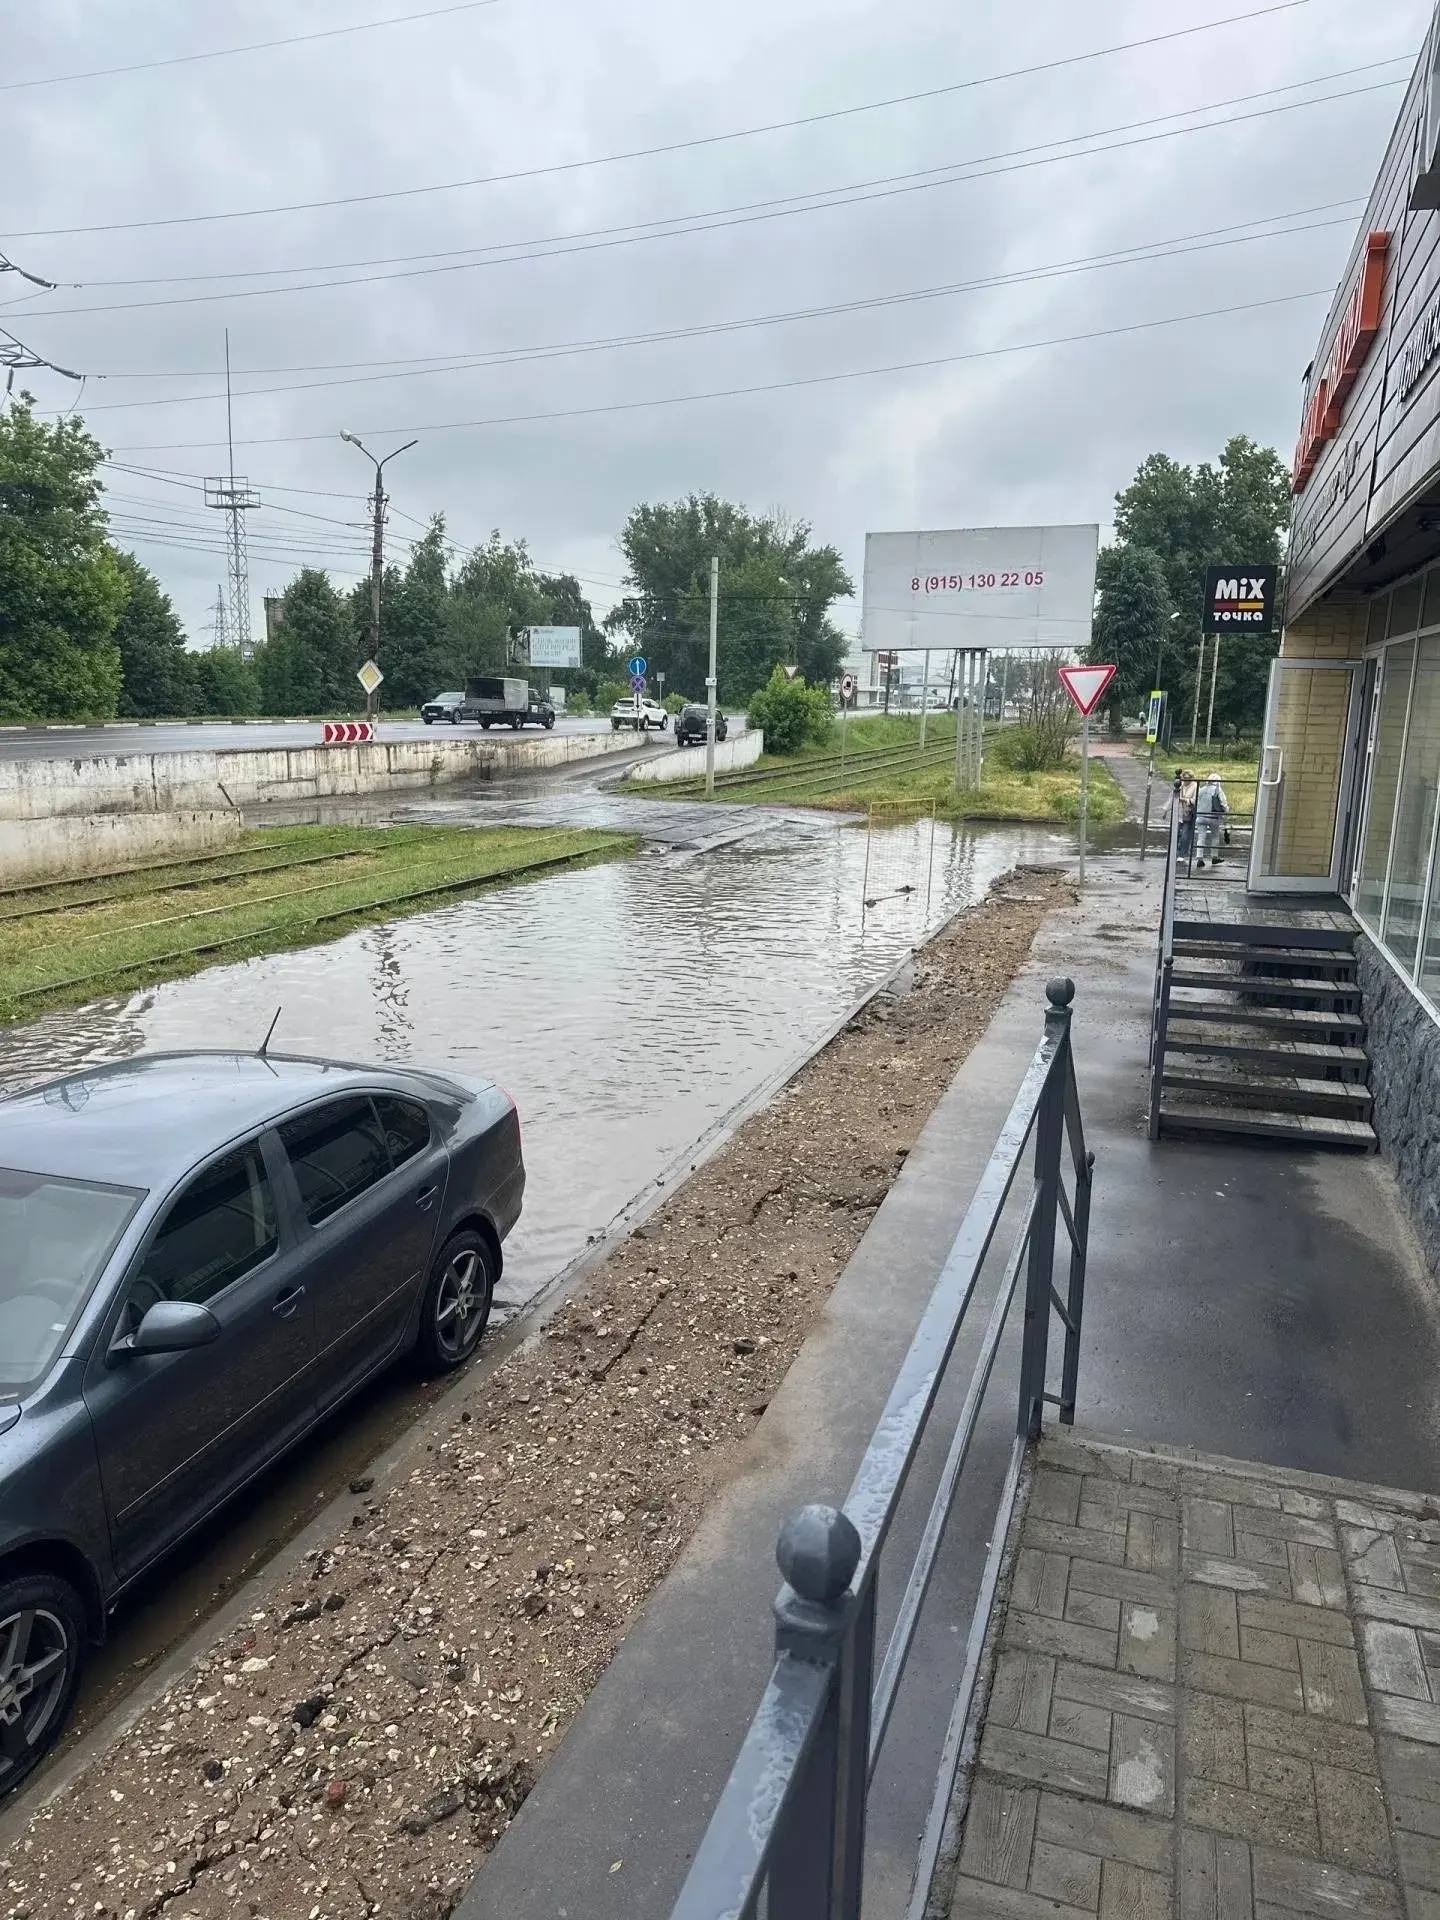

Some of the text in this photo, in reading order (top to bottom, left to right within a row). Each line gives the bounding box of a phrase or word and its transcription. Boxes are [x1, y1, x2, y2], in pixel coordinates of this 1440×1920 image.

[911, 571, 1044, 593] 8 (915) 130 22 05
[1213, 611, 1264, 622] точка
